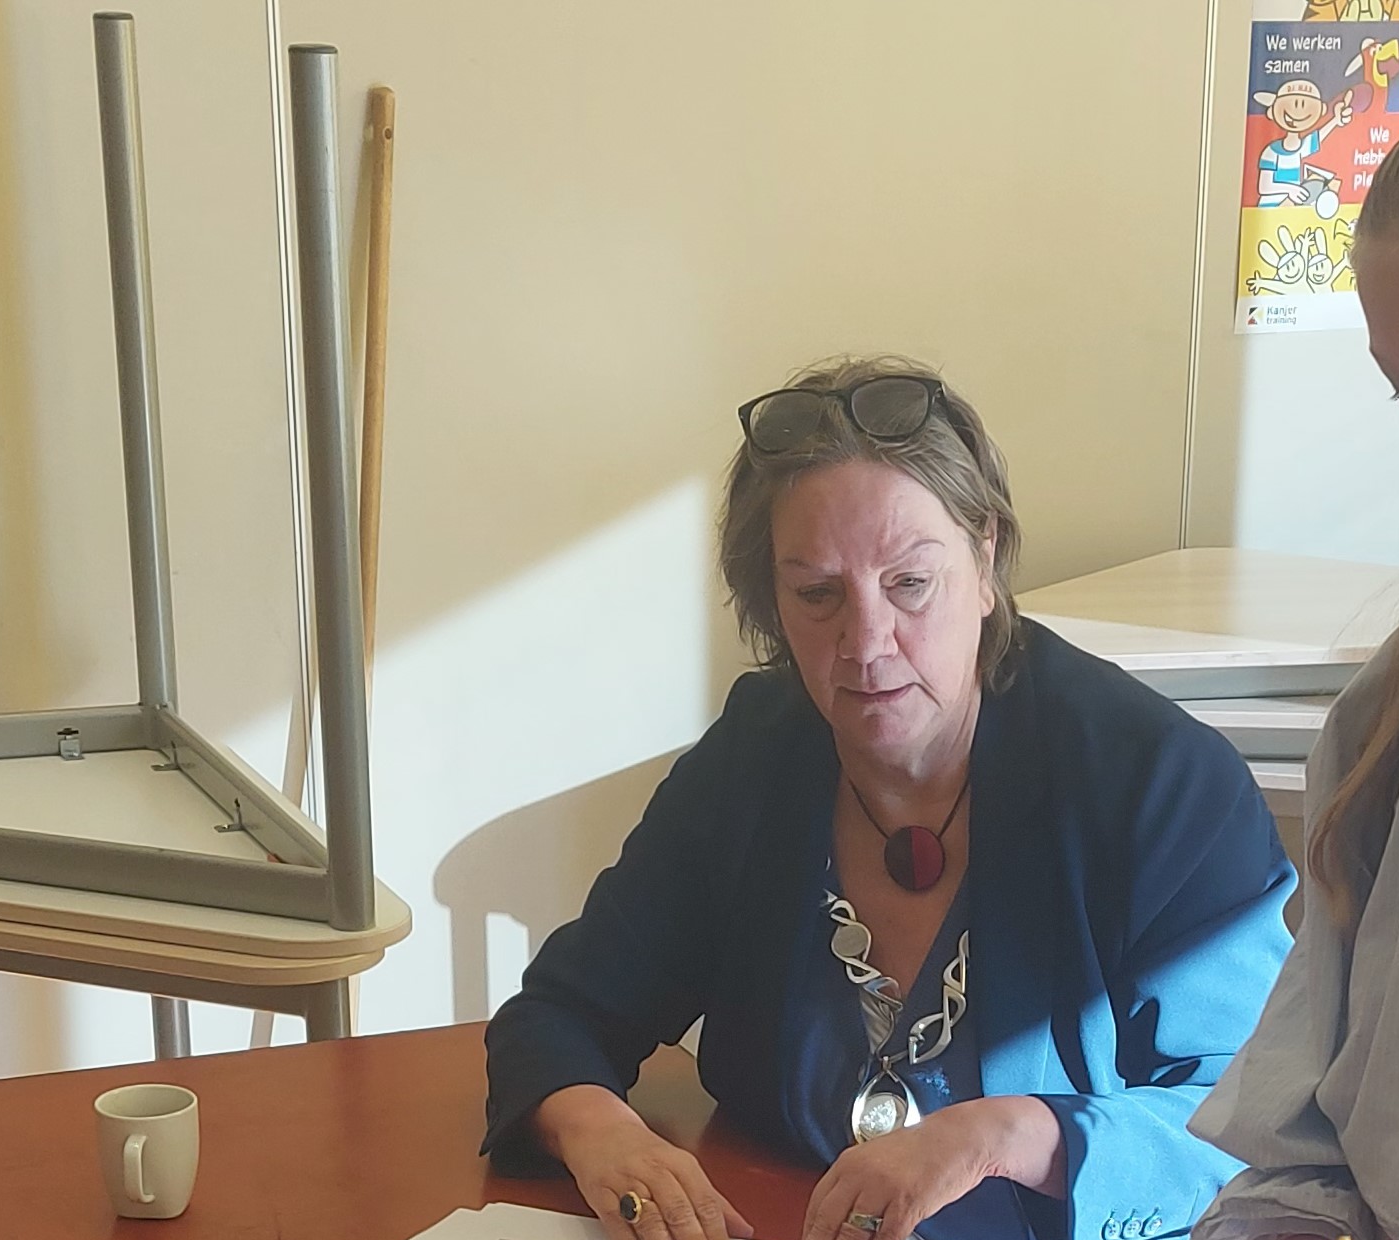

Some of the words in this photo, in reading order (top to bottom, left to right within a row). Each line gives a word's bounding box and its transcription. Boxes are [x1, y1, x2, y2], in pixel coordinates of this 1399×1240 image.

[1266, 33, 1287, 52] We
[1292, 33, 1341, 51] werken
[1264, 59, 1310, 74] samen
[1369, 125, 1390, 145] We
[1353, 147, 1386, 166] hebb
[1266, 305, 1297, 317] Kanjer
[1265, 316, 1297, 326] training
